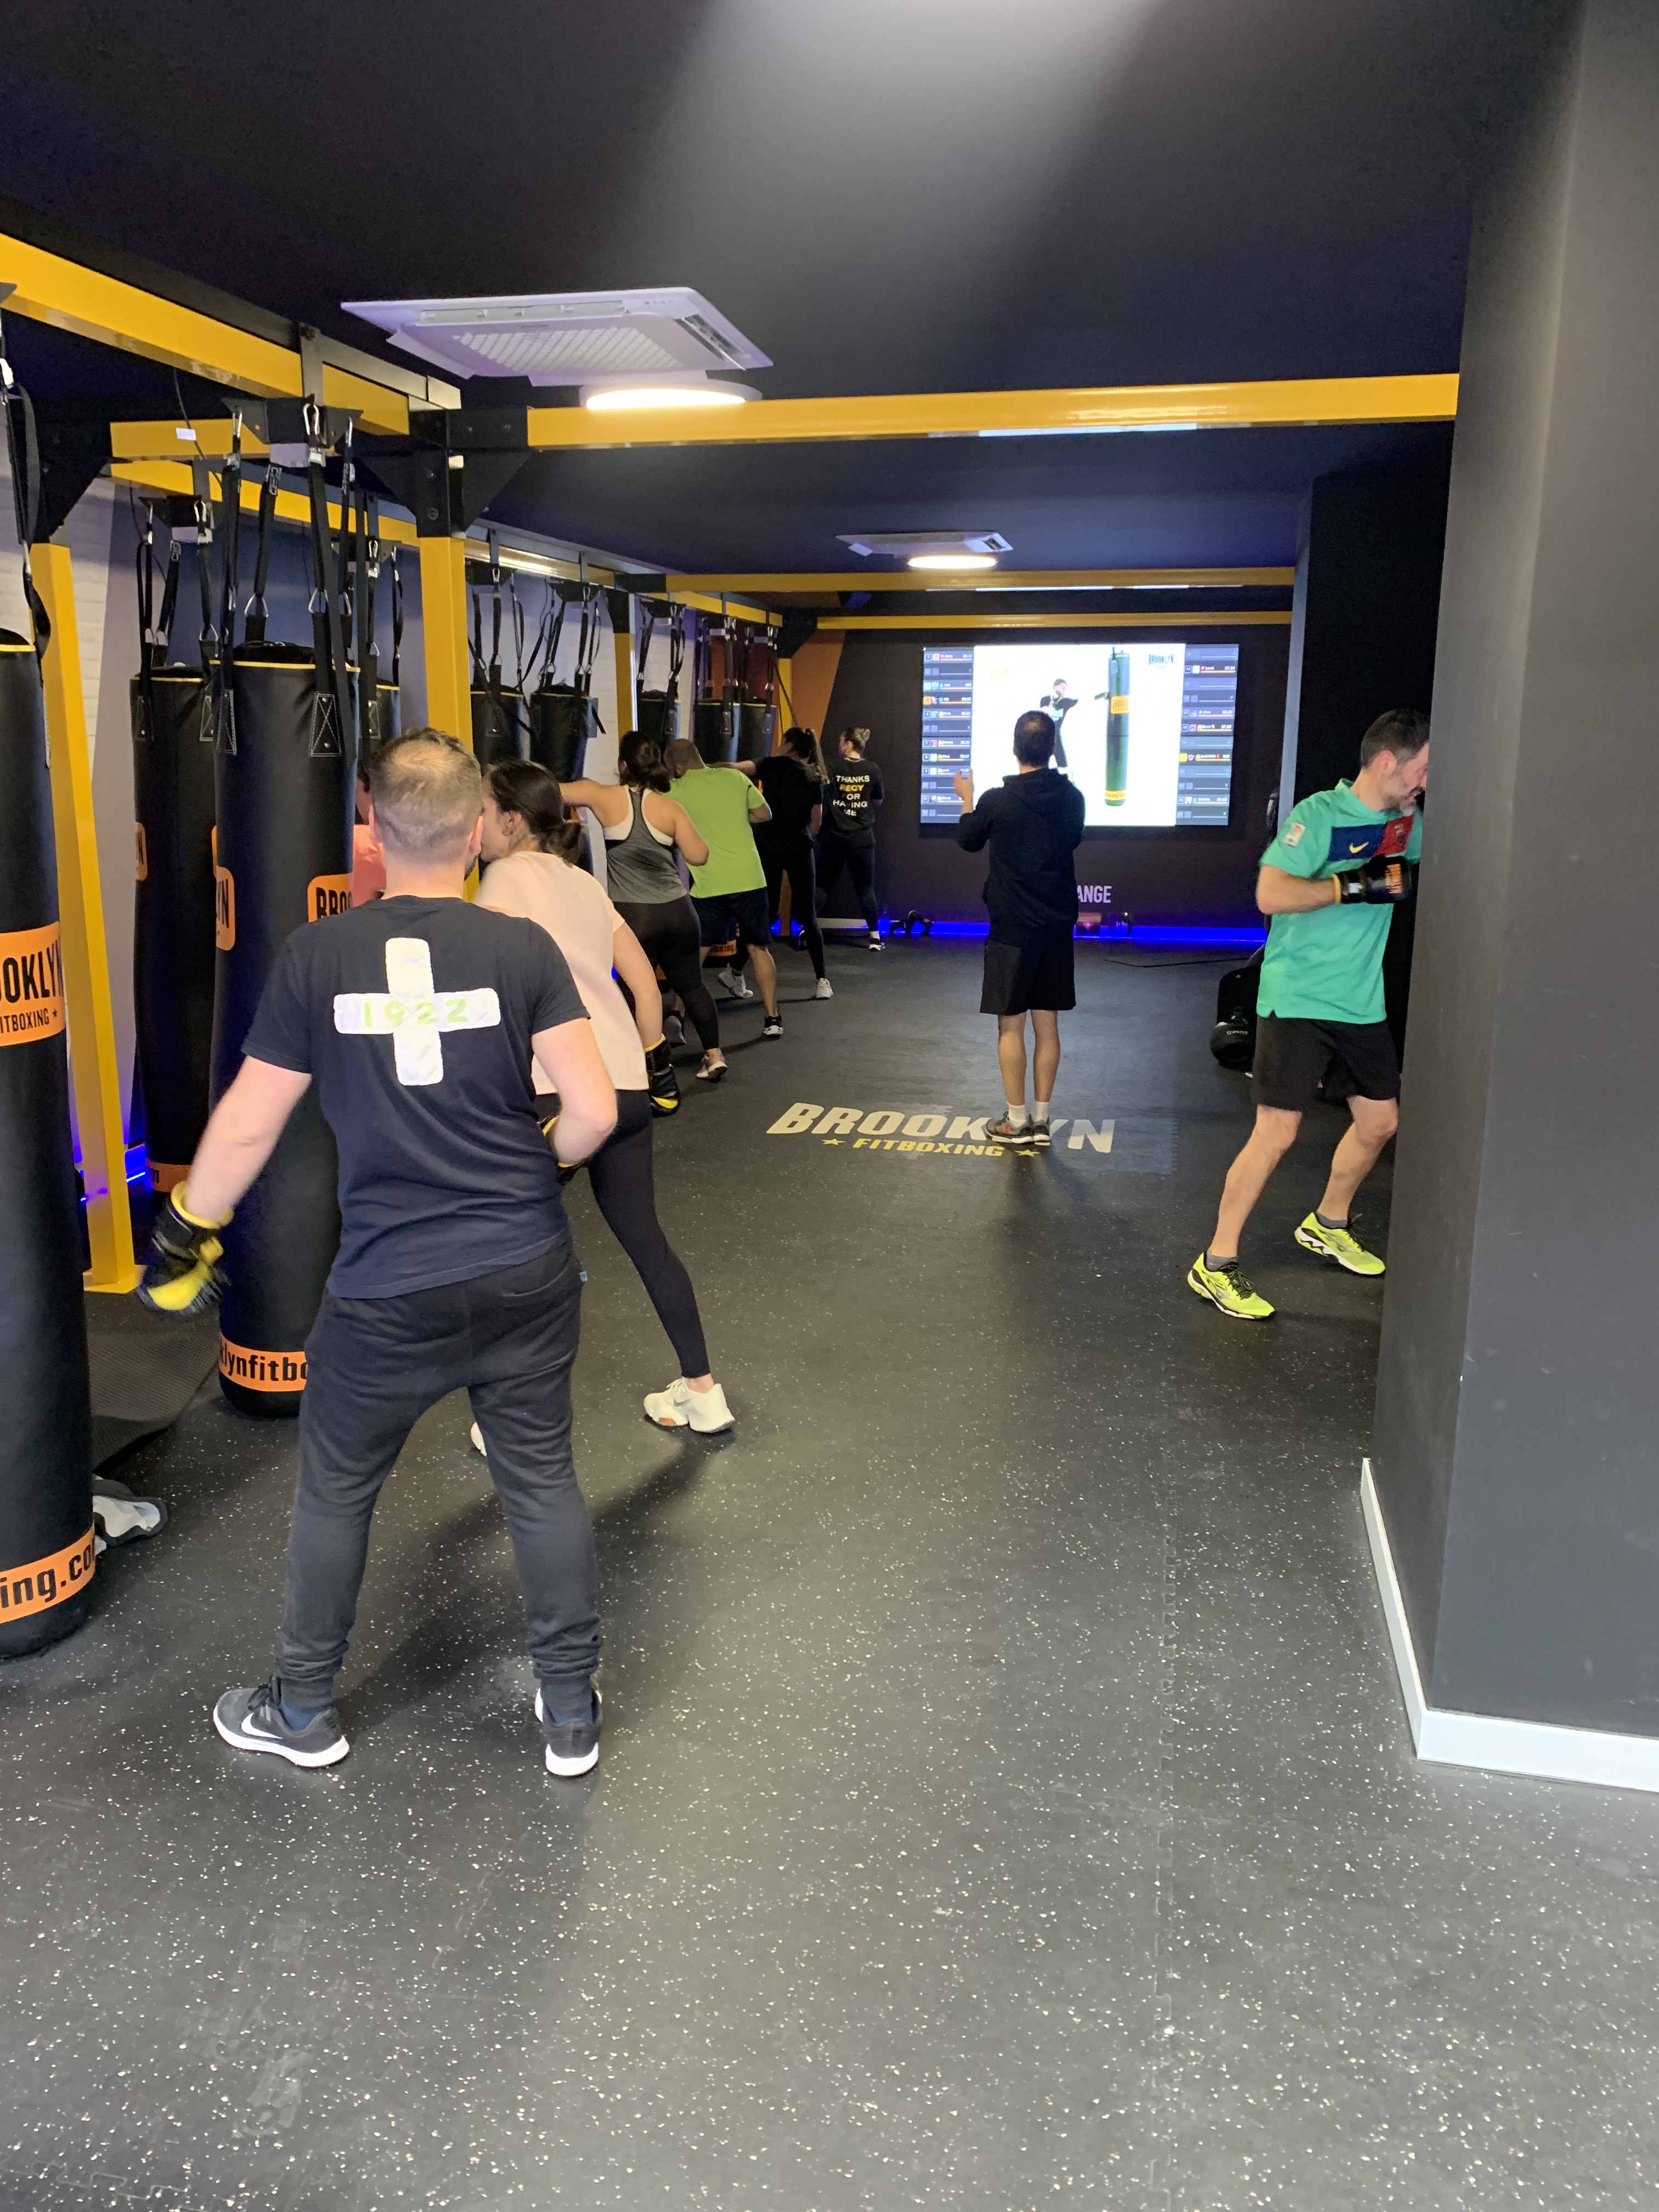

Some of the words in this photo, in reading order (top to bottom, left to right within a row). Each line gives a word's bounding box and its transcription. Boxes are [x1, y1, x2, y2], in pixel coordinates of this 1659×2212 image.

[1149, 654, 1174, 665] BROOKLYN
[836, 775, 870, 783] THANKS
[0, 936, 64, 1003] OKLYN
[364, 998, 469, 1028] 1922
[766, 1102, 1115, 1153] BROOKYN
[853, 1138, 1005, 1156] FITBOXING
